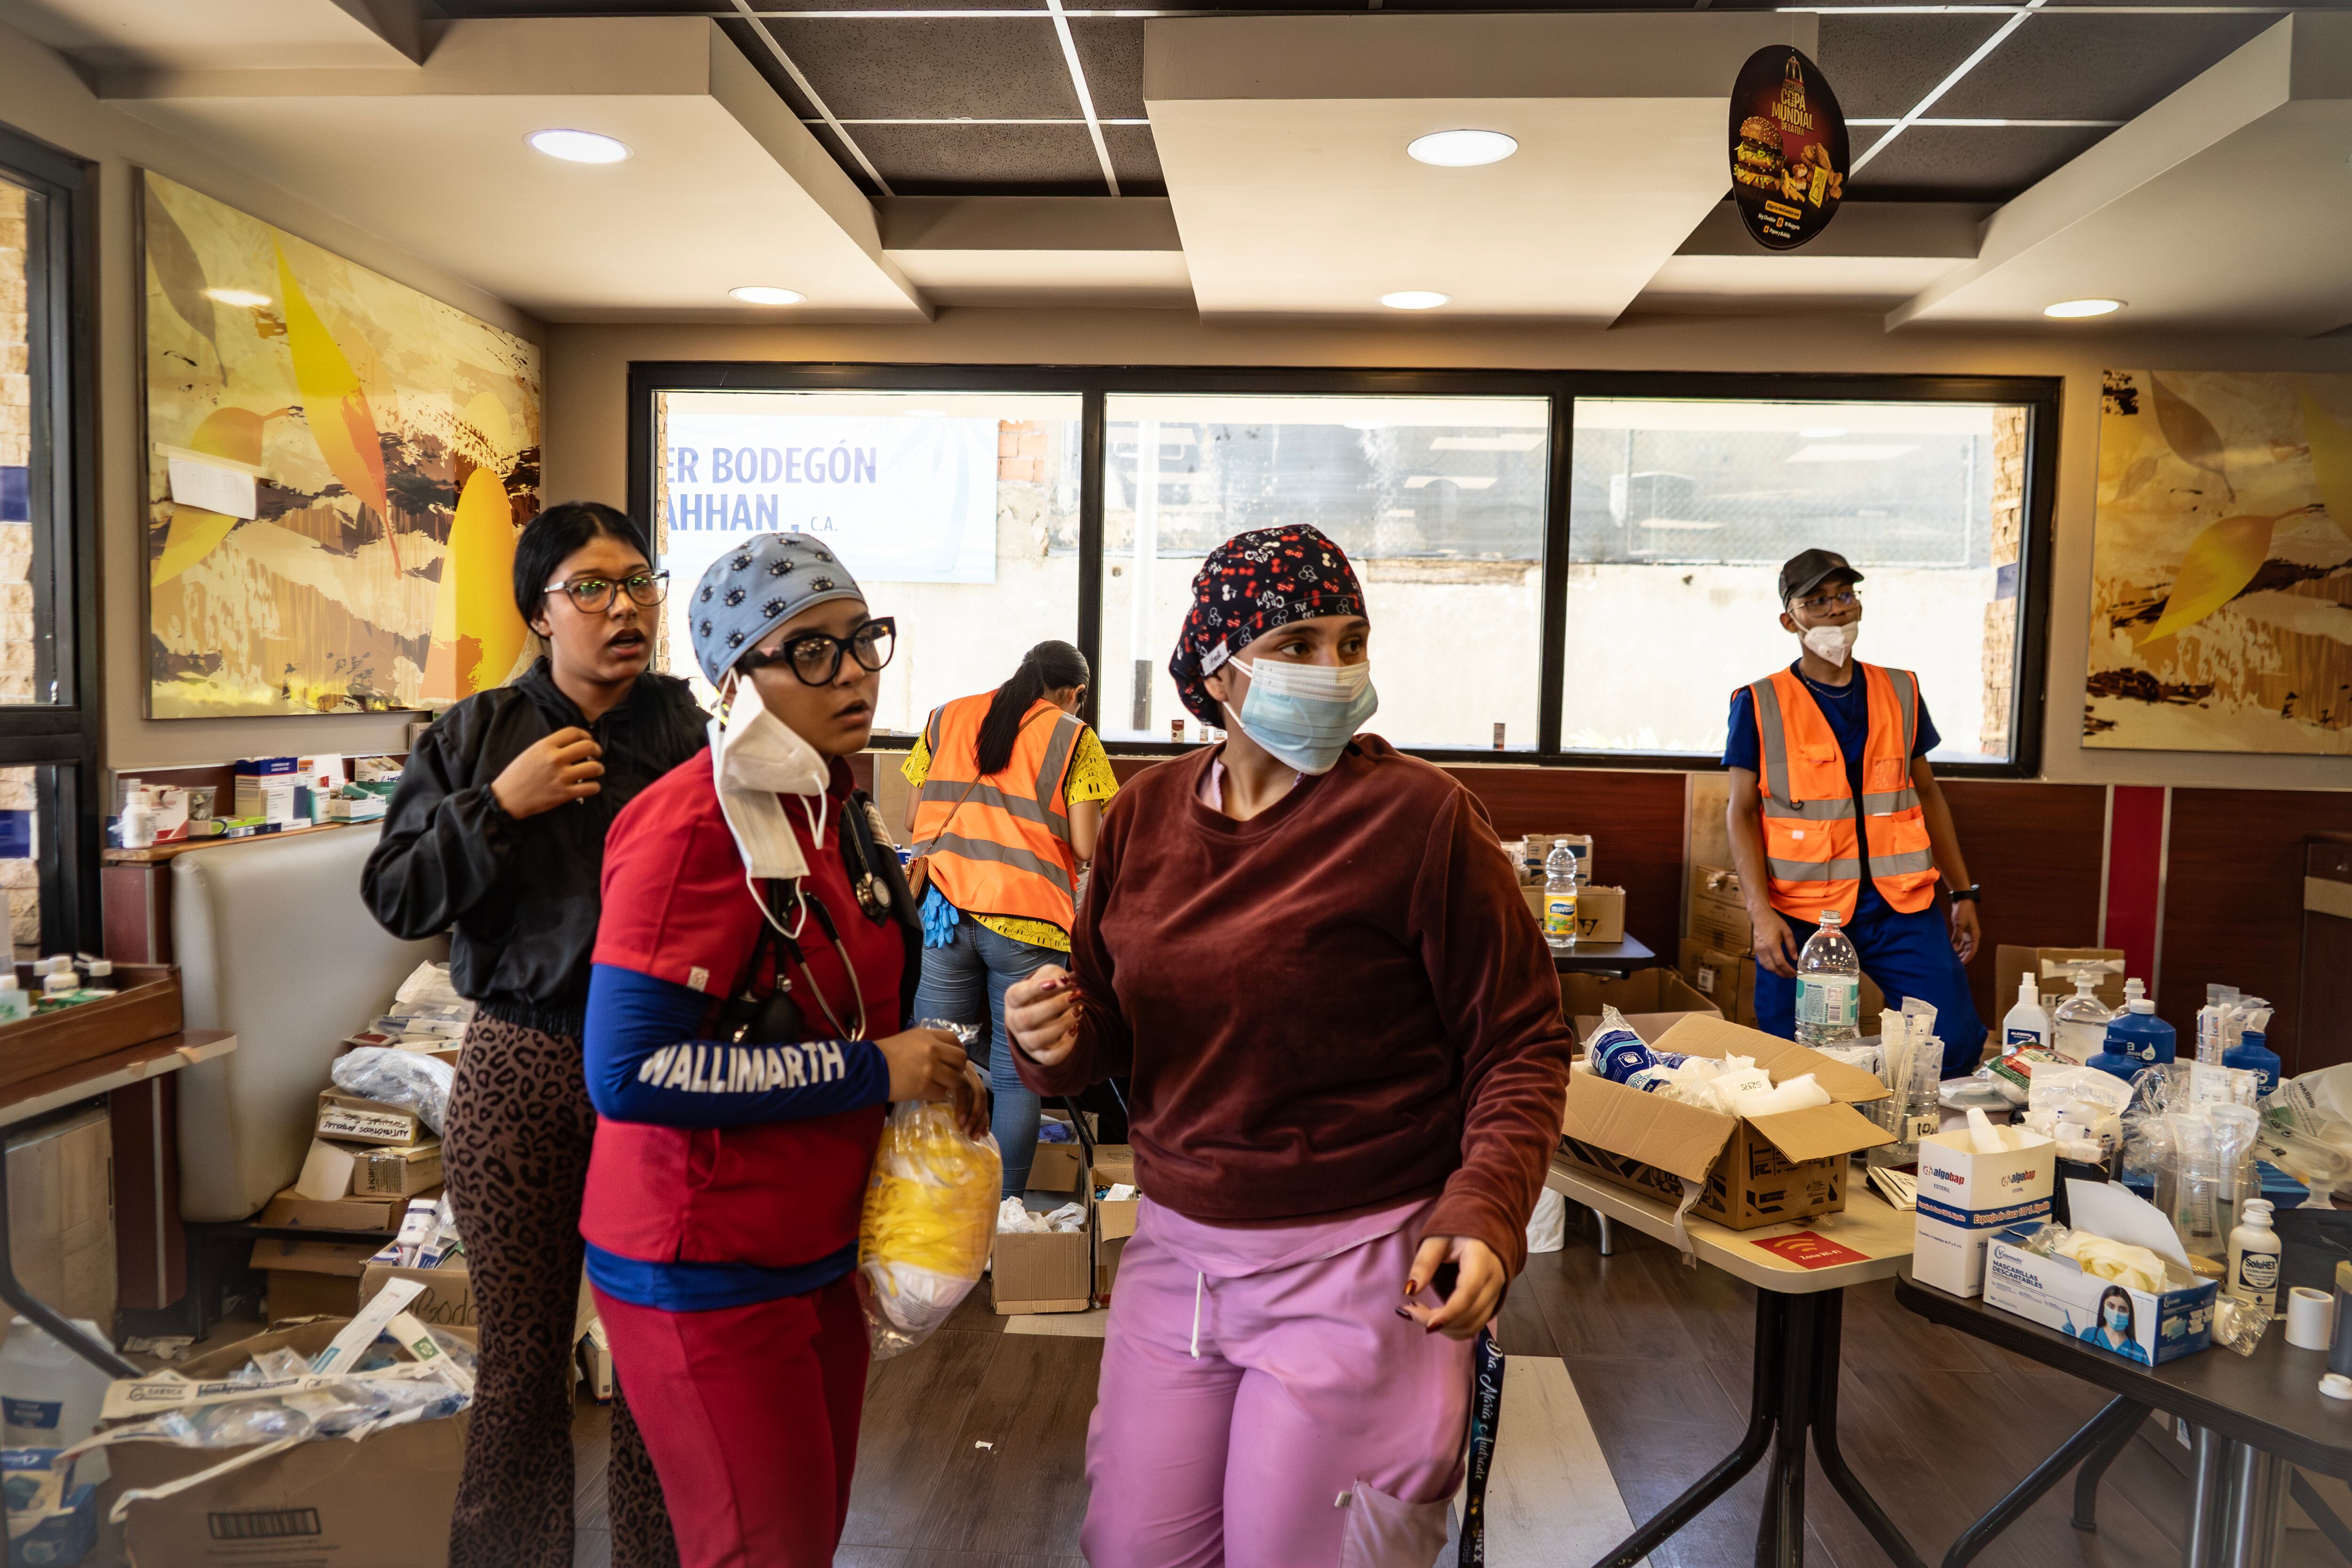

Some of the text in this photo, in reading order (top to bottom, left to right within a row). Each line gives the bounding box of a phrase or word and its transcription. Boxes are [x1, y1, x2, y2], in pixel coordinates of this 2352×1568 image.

[1772, 101, 1814, 131] MUNDIAL
[1781, 121, 1788, 131] DE
[1788, 124, 1794, 133] LA
[712, 439, 876, 484] BODEGÓN
[811, 517, 838, 531] C.A.
[638, 1041, 846, 1093] WALLIMARTH
[1933, 1168, 1965, 1186] algobap
[2010, 1170, 2036, 1184] algobap
[1973, 1212, 1997, 1225] Esponja
[1997, 1211, 2005, 1221] de
[2005, 1210, 2018, 1220] Gasa
[2018, 1206, 2028, 1217] 100
[2034, 1201, 2050, 1214] Algodón
[1992, 1266, 2043, 1289] DESCARTABLES
[1993, 1260, 2038, 1281] MASCARILLAS
[1486, 1338, 1503, 1371] Dra.
